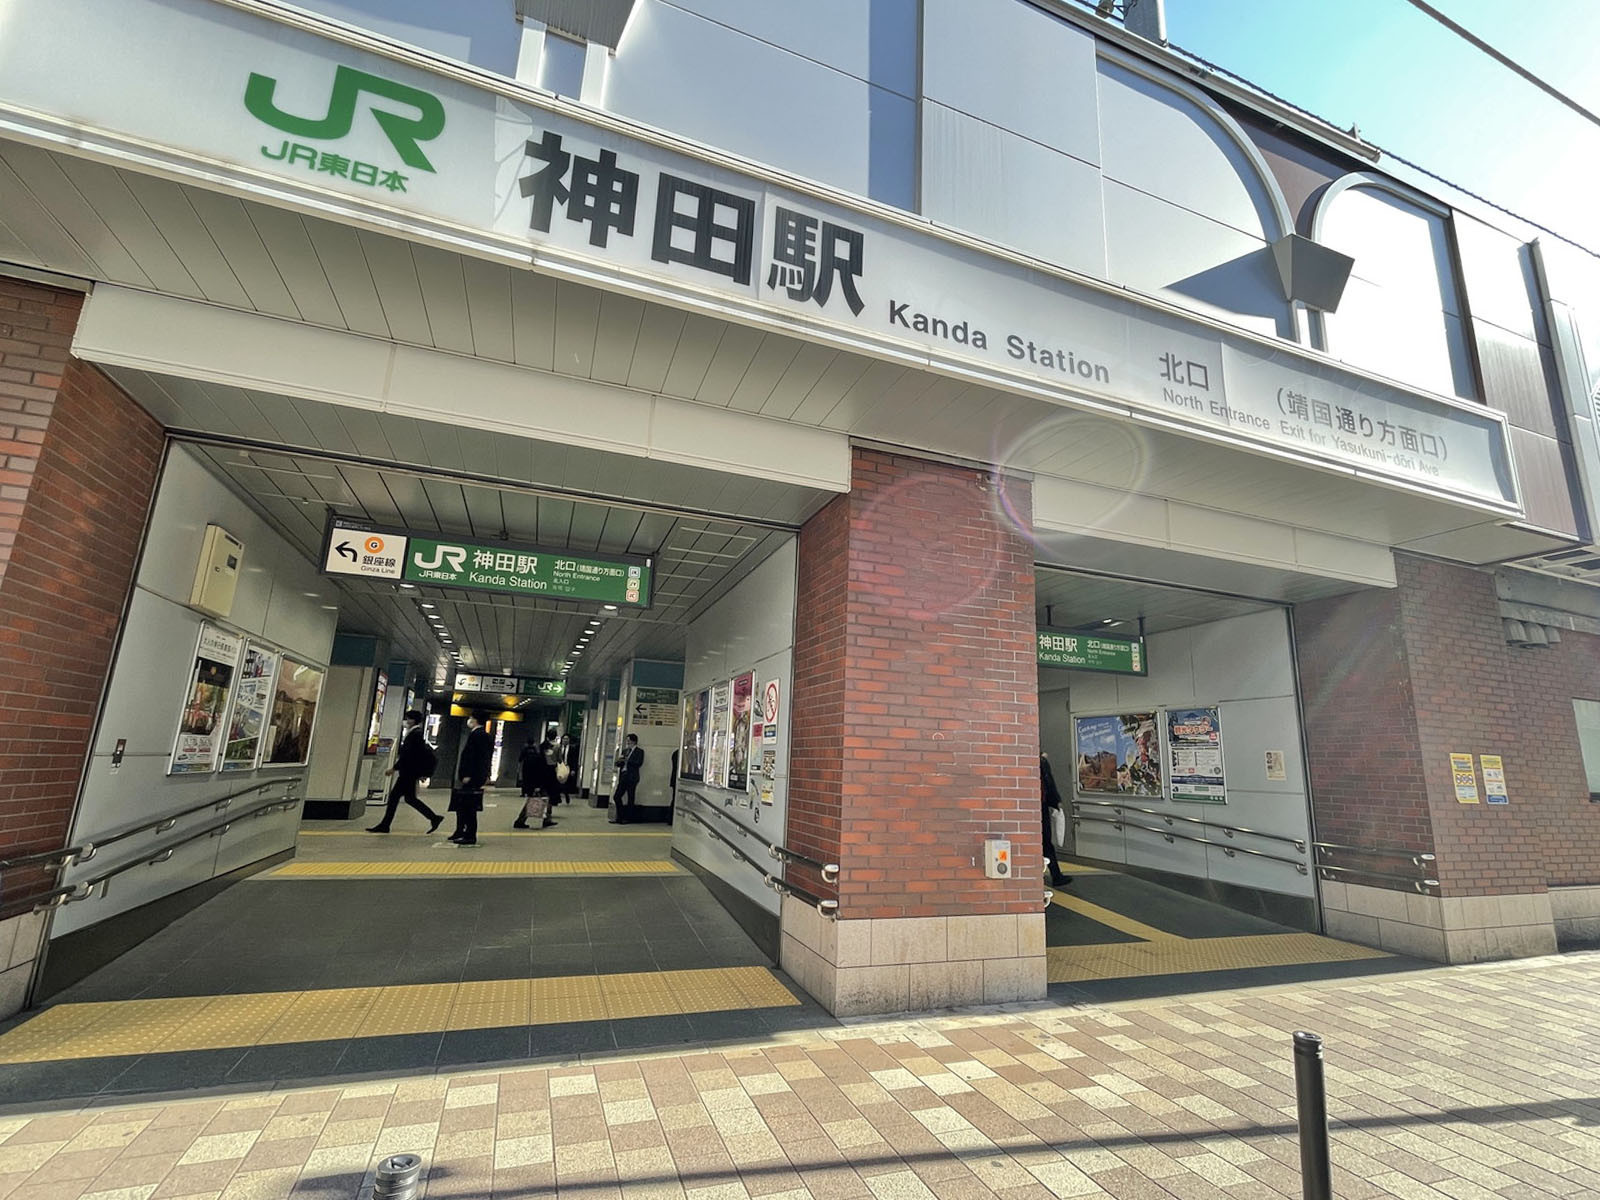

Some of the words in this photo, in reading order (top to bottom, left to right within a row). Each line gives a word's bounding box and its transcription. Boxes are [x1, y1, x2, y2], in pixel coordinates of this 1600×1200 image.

[244, 65, 446, 174] JR
[261, 140, 409, 193] JR東日本
[519, 130, 865, 317] 神田駅
[889, 299, 988, 350] Kanda
[1007, 334, 1110, 384] Station
[1159, 352, 1209, 391] 北口
[1163, 387, 1203, 412] North
[1210, 400, 1270, 430] Entrance
[1280, 420, 1306, 441] Exit
[1309, 428, 1327, 445] for
[363, 554, 397, 568] 銀座線
[414, 545, 467, 572] JR
[472, 550, 538, 575] 神田駅
[554, 560, 576, 571] 北口
[360, 565, 380, 573] Ginza
[418, 570, 458, 580] JR東日本
[553, 570, 571, 578] North
[572, 572, 600, 582] Entrance
[469, 572, 506, 586] Kanda
[508, 575, 547, 590] Station
[1039, 634, 1078, 652] 神田駅
[1087, 640, 1100, 649] 北口
[1039, 651, 1061, 662] Kanda
[1062, 653, 1086, 665] Station
[537, 682, 553, 691] JR
